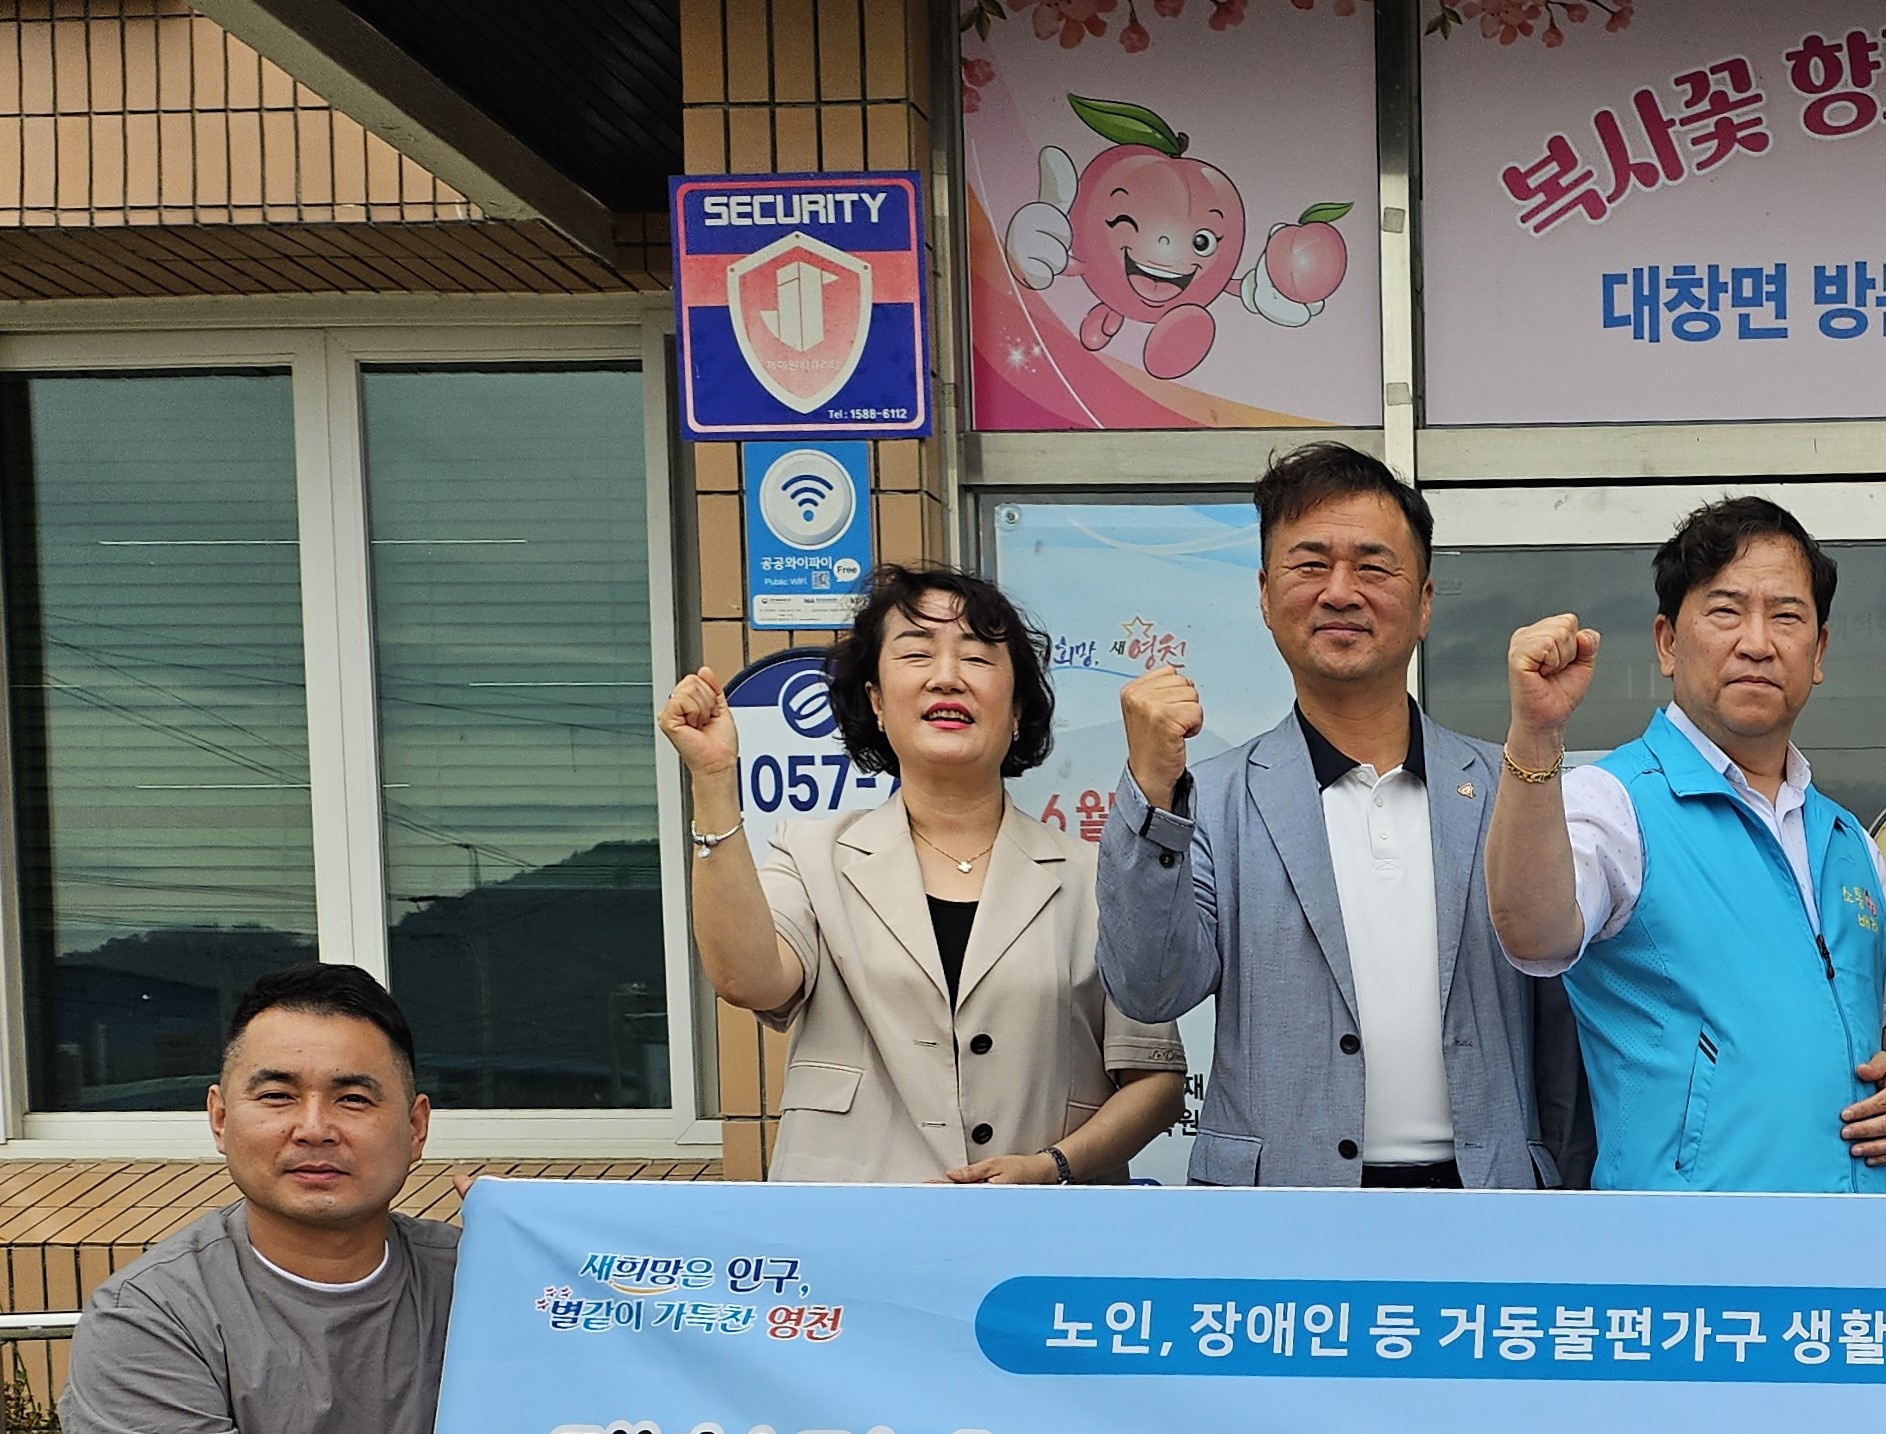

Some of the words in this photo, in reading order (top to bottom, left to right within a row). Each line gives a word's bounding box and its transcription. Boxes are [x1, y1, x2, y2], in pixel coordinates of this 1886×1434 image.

[1503, 58, 1770, 234] 복사꽃
[704, 193, 887, 226] SECURITY
[1601, 262, 1789, 343] 대창면
[850, 408, 908, 420] 1588-6112
[761, 556, 833, 571] 공공와이파이
[837, 565, 858, 574] Free
[737, 754, 902, 813] 057-
[579, 1252, 714, 1289] 새희망은
[727, 1255, 809, 1297] 인구,
[550, 1299, 645, 1331] 별같이
[652, 1300, 755, 1334] 가득찬
[767, 1306, 842, 1341] 영천
[1045, 1301, 1173, 1359] 노인,
[1190, 1301, 1349, 1357] 장애인
[1368, 1305, 1422, 1359] 등
[1439, 1305, 1767, 1363] 거동불편가구
